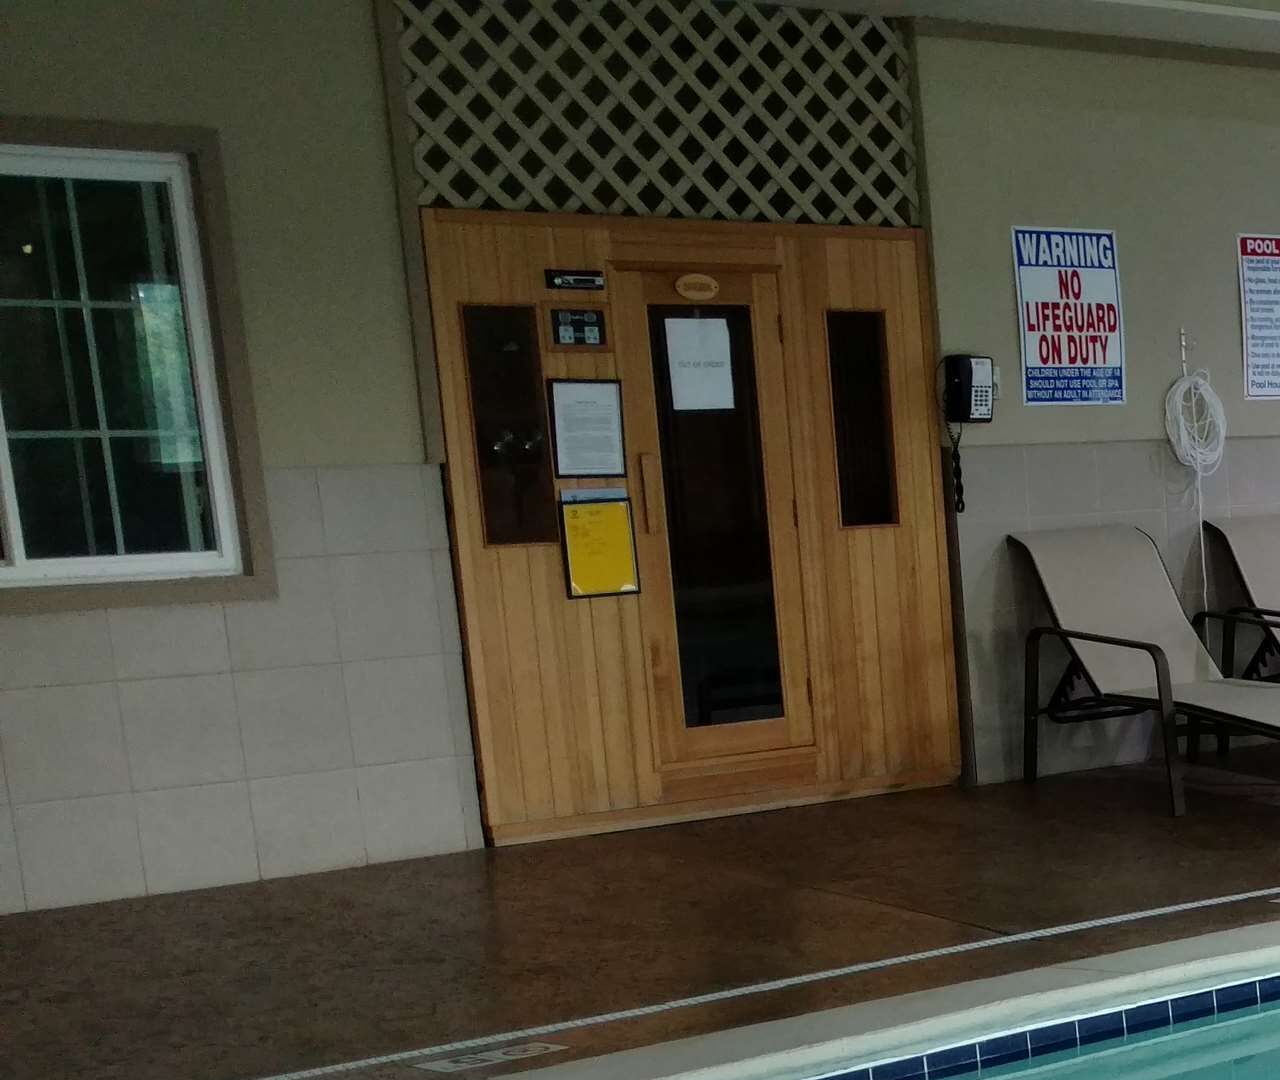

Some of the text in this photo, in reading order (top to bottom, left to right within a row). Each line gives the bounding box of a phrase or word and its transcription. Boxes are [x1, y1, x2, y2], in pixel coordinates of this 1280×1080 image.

[1017, 233, 1113, 267] WARNING
[1246, 239, 1279, 254] POOL
[1058, 269, 1082, 300] NO
[1025, 301, 1117, 333] LIFEGUARD
[1038, 334, 1109, 365] ON DUTY
[1027, 368, 1058, 377] CHILDREN
[1059, 368, 1080, 377] UNDER
[1080, 368, 1091, 377] THE
[1029, 379, 1055, 388] SHOULD
[1055, 379, 1068, 388] NOT
[1069, 379, 1081, 388] USE
[1082, 379, 1098, 388] POOL
[1107, 379, 1119, 388] SPA
[1250, 380, 1266, 389] Pool
[1027, 389, 1053, 398] WITHOUT
[1054, 389, 1062, 398] AN
[1063, 389, 1081, 398] ADULT
